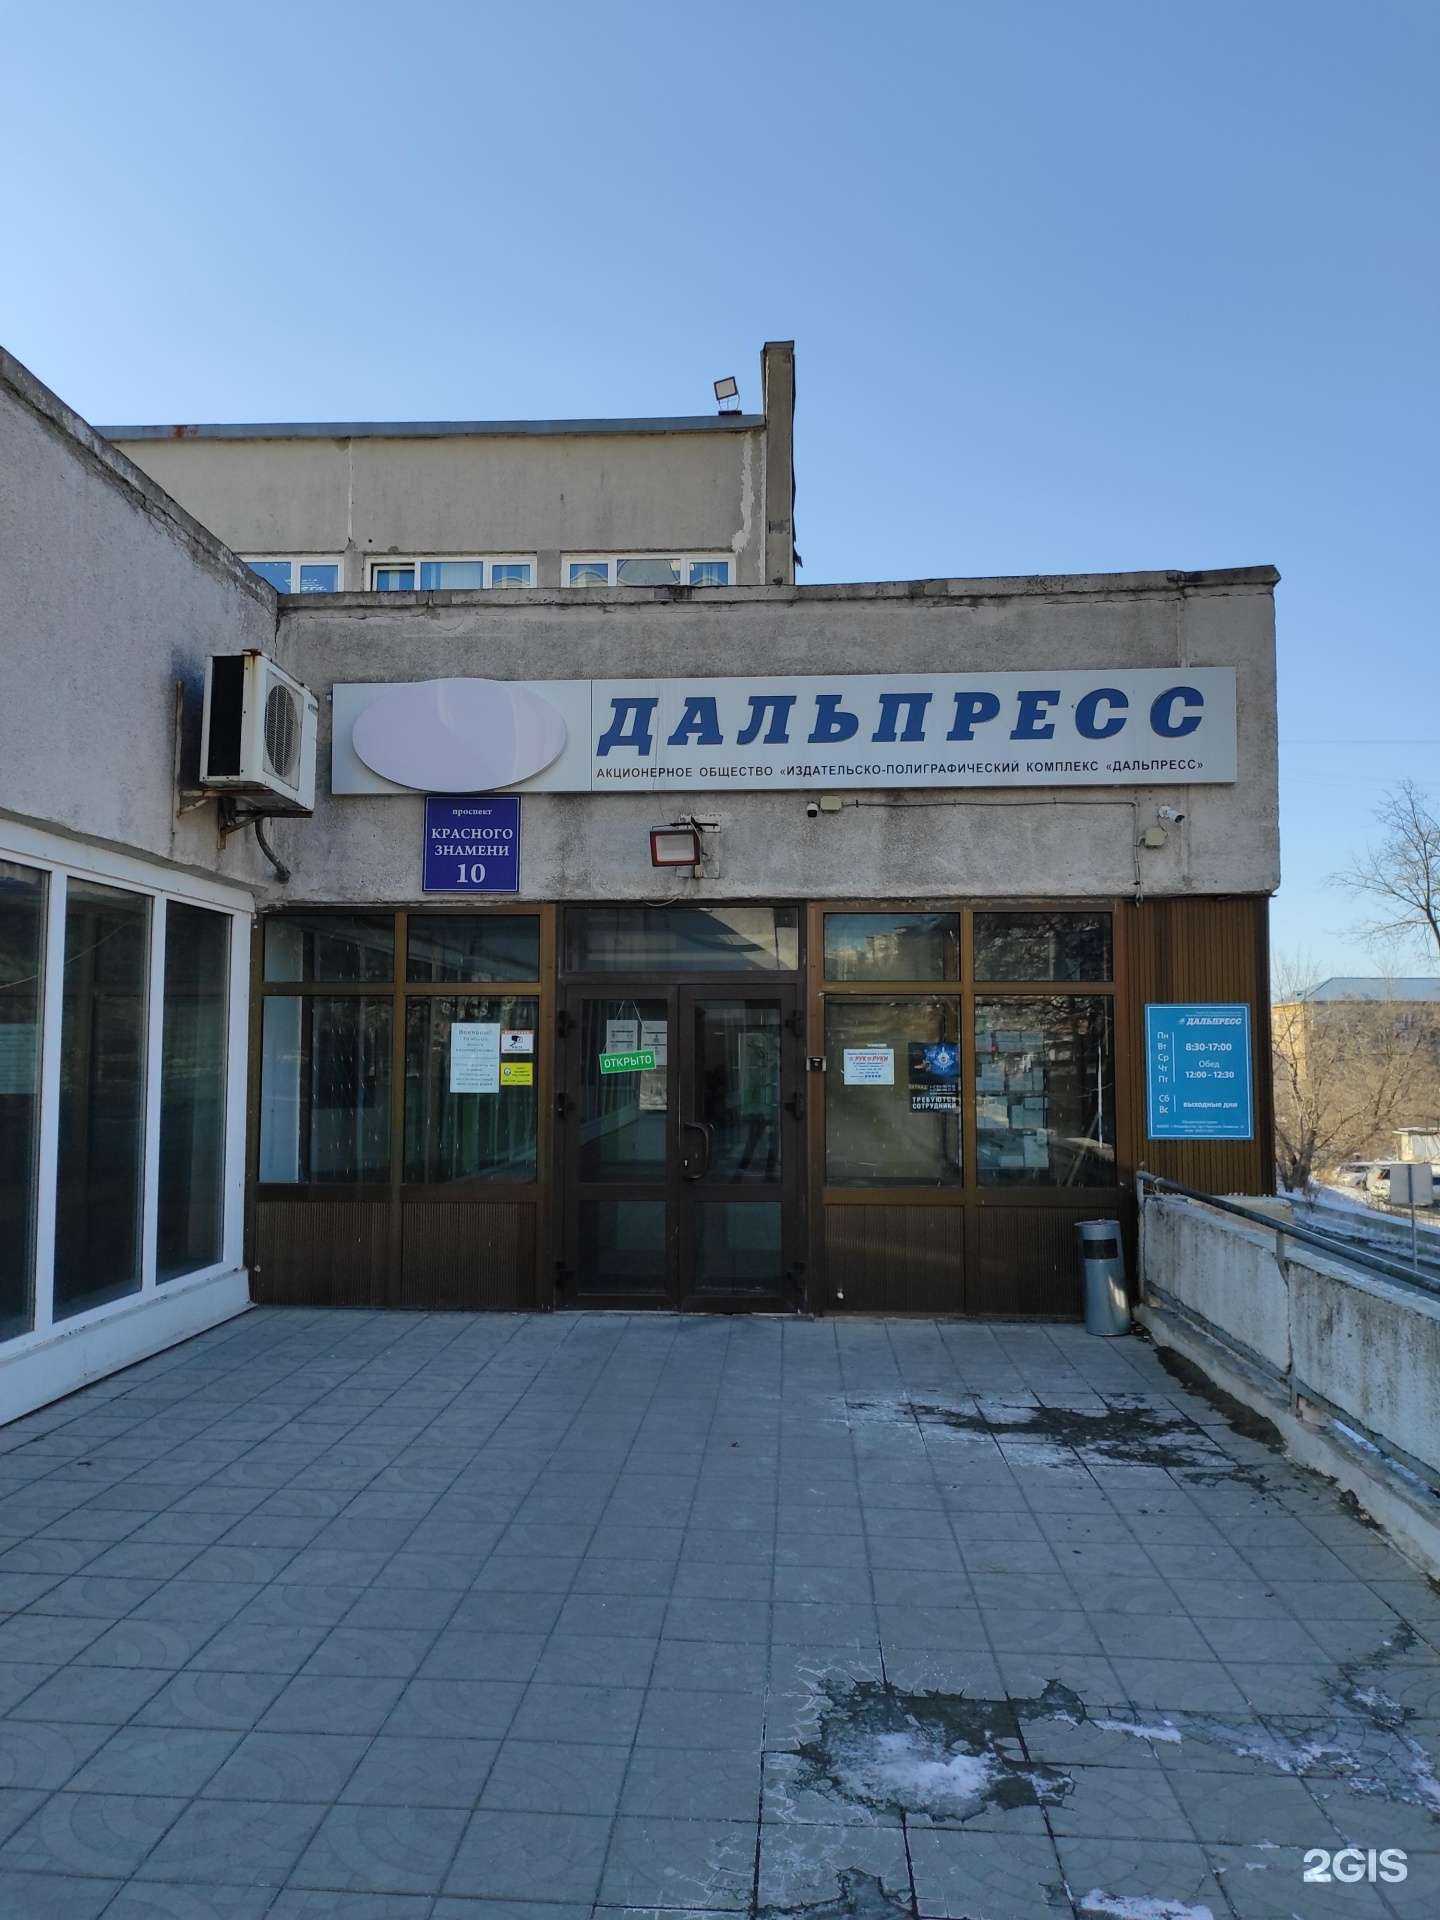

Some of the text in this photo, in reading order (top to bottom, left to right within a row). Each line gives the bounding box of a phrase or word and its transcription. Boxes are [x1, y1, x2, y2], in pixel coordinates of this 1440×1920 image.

[596, 686, 1205, 757] ДАЛЬПРЕСС
[596, 759, 1204, 780] АКЦИОНЕРНОЕ ОБЩЕСТВО «ИЗДАТЕЛЬСКО-ПОЛИГРАФИЧЕСКИЙ КОМПЛЕКС «ДАЛЬПРЕСС»
[452, 808, 493, 817] проспект
[431, 828, 514, 840] КРАСНОГО
[434, 844, 510, 857] ЗНАМЕНИ
[456, 863, 486, 884] 10
[1186, 1017, 1242, 1026] ДАЛЬПРЕСС
[1157, 1031, 1169, 1040] Пн
[1158, 1042, 1167, 1051] Вт
[1185, 1042, 1233, 1052] 8:30-17:00
[604, 1055, 652, 1069] ОТКРЫТО
[1158, 1053, 1169, 1063] Ср
[1158, 1064, 1168, 1072] Чт
[1198, 1059, 1220, 1069] Обед
[1158, 1075, 1168, 1083] Пт
[1185, 1071, 1206, 1079] 12:00
[1214, 1070, 1235, 1079] 12:30
[1159, 1094, 1170, 1103] Сб
[1160, 1106, 1169, 1114] Вс
